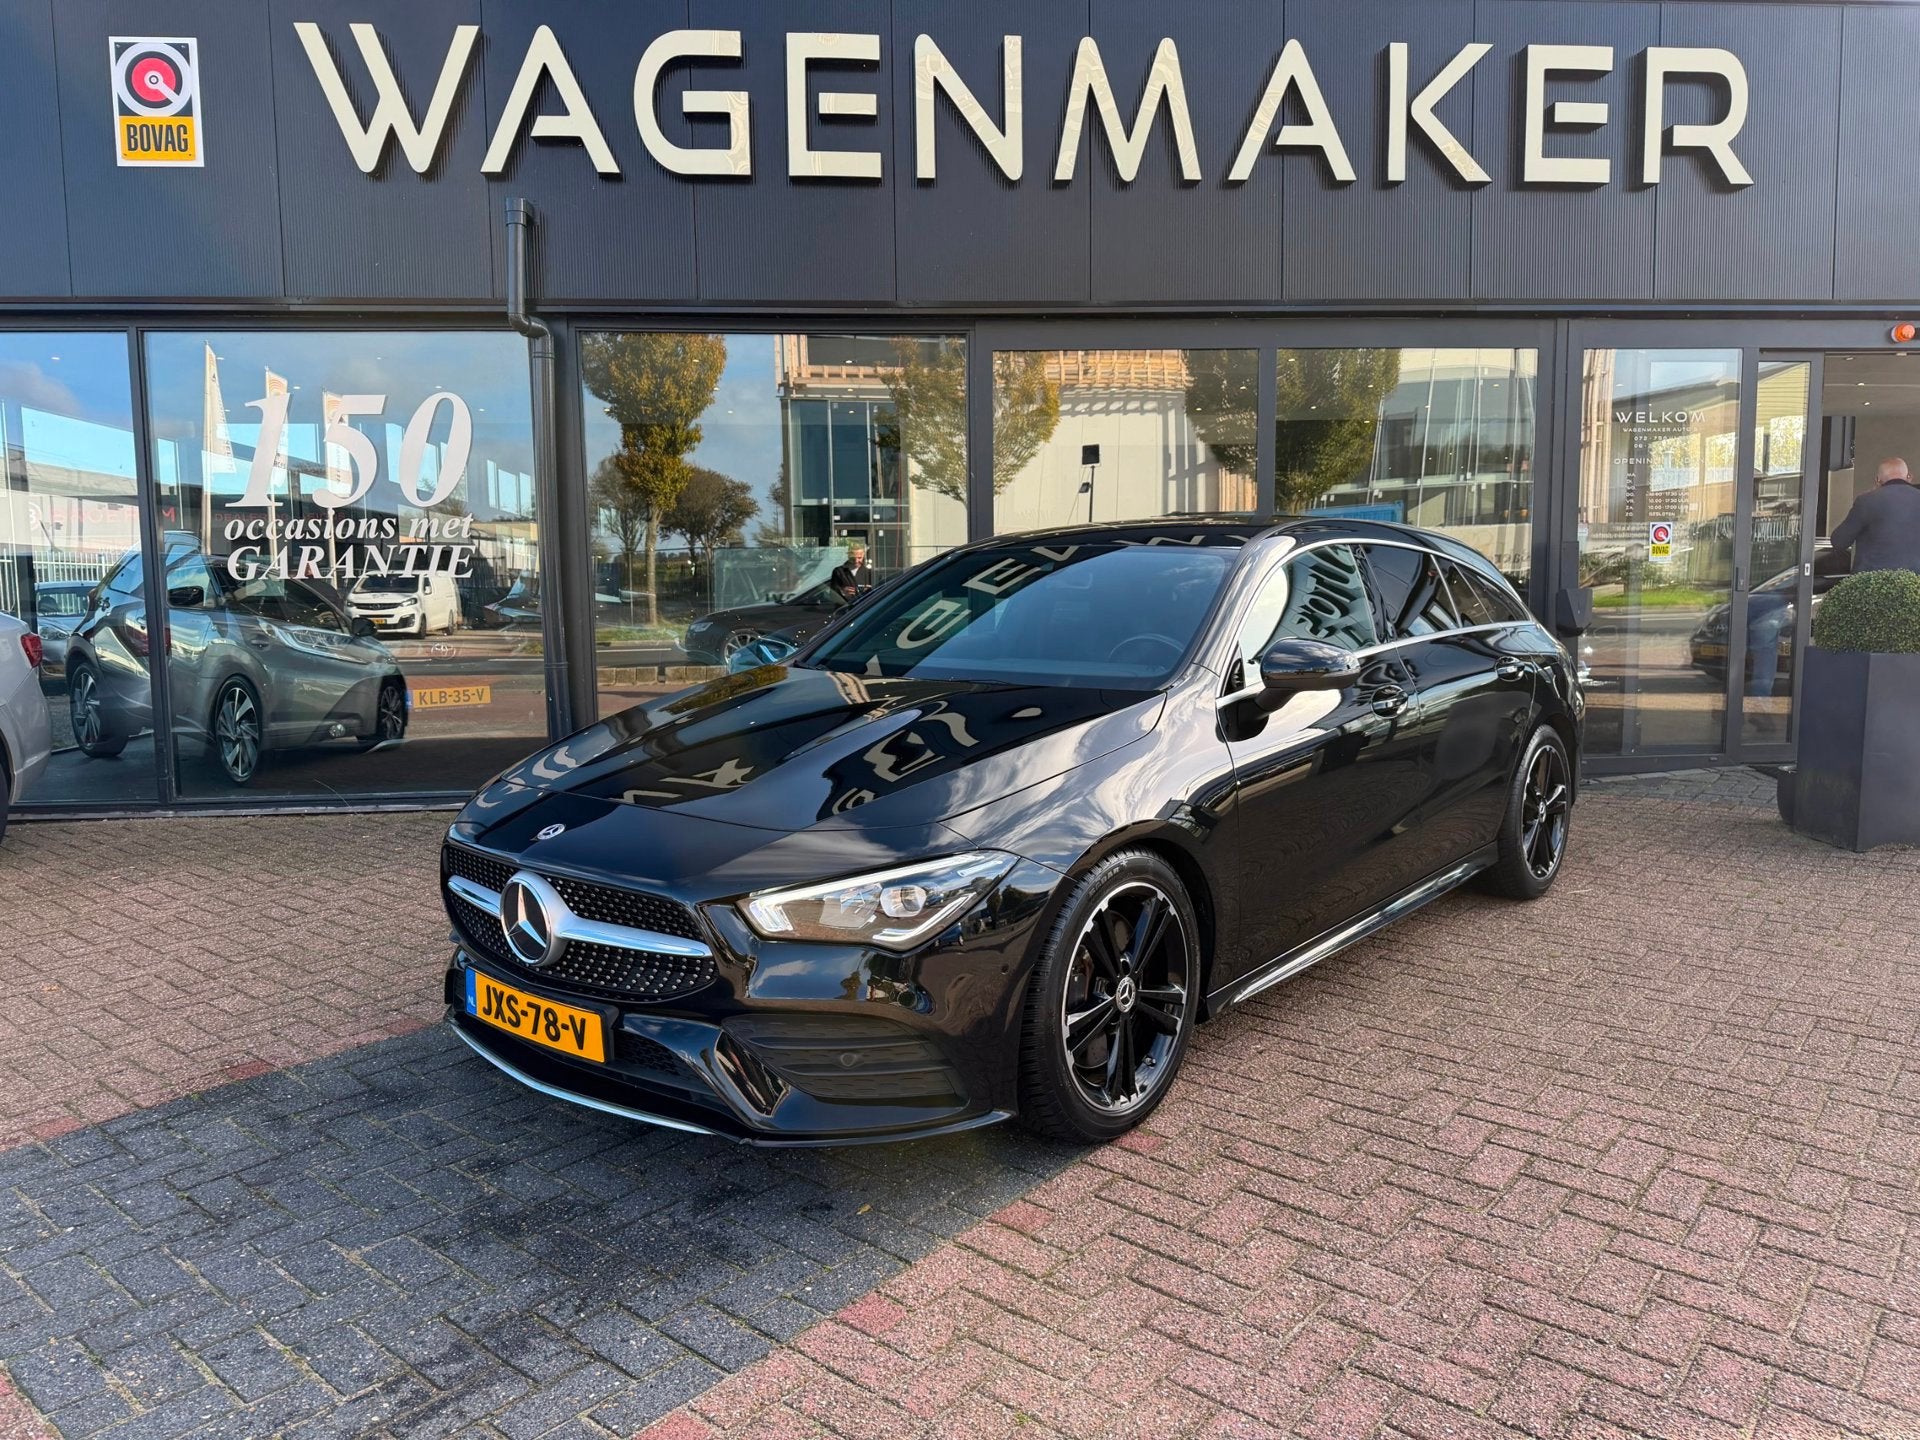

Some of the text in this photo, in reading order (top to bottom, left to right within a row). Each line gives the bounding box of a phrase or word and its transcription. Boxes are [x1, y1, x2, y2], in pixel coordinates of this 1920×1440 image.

[293, 22, 1755, 186] WAGENMAKER
[126, 123, 189, 152] BOVAG
[1615, 411, 1705, 423] WELKOM
[224, 391, 473, 508] 150
[223, 507, 475, 541] occasions met
[226, 544, 477, 581] GARANTIE
[1652, 545, 1670, 555] BOVAG
[418, 687, 485, 706] KLB-35-V
[482, 983, 587, 1051] JXS-78-V
